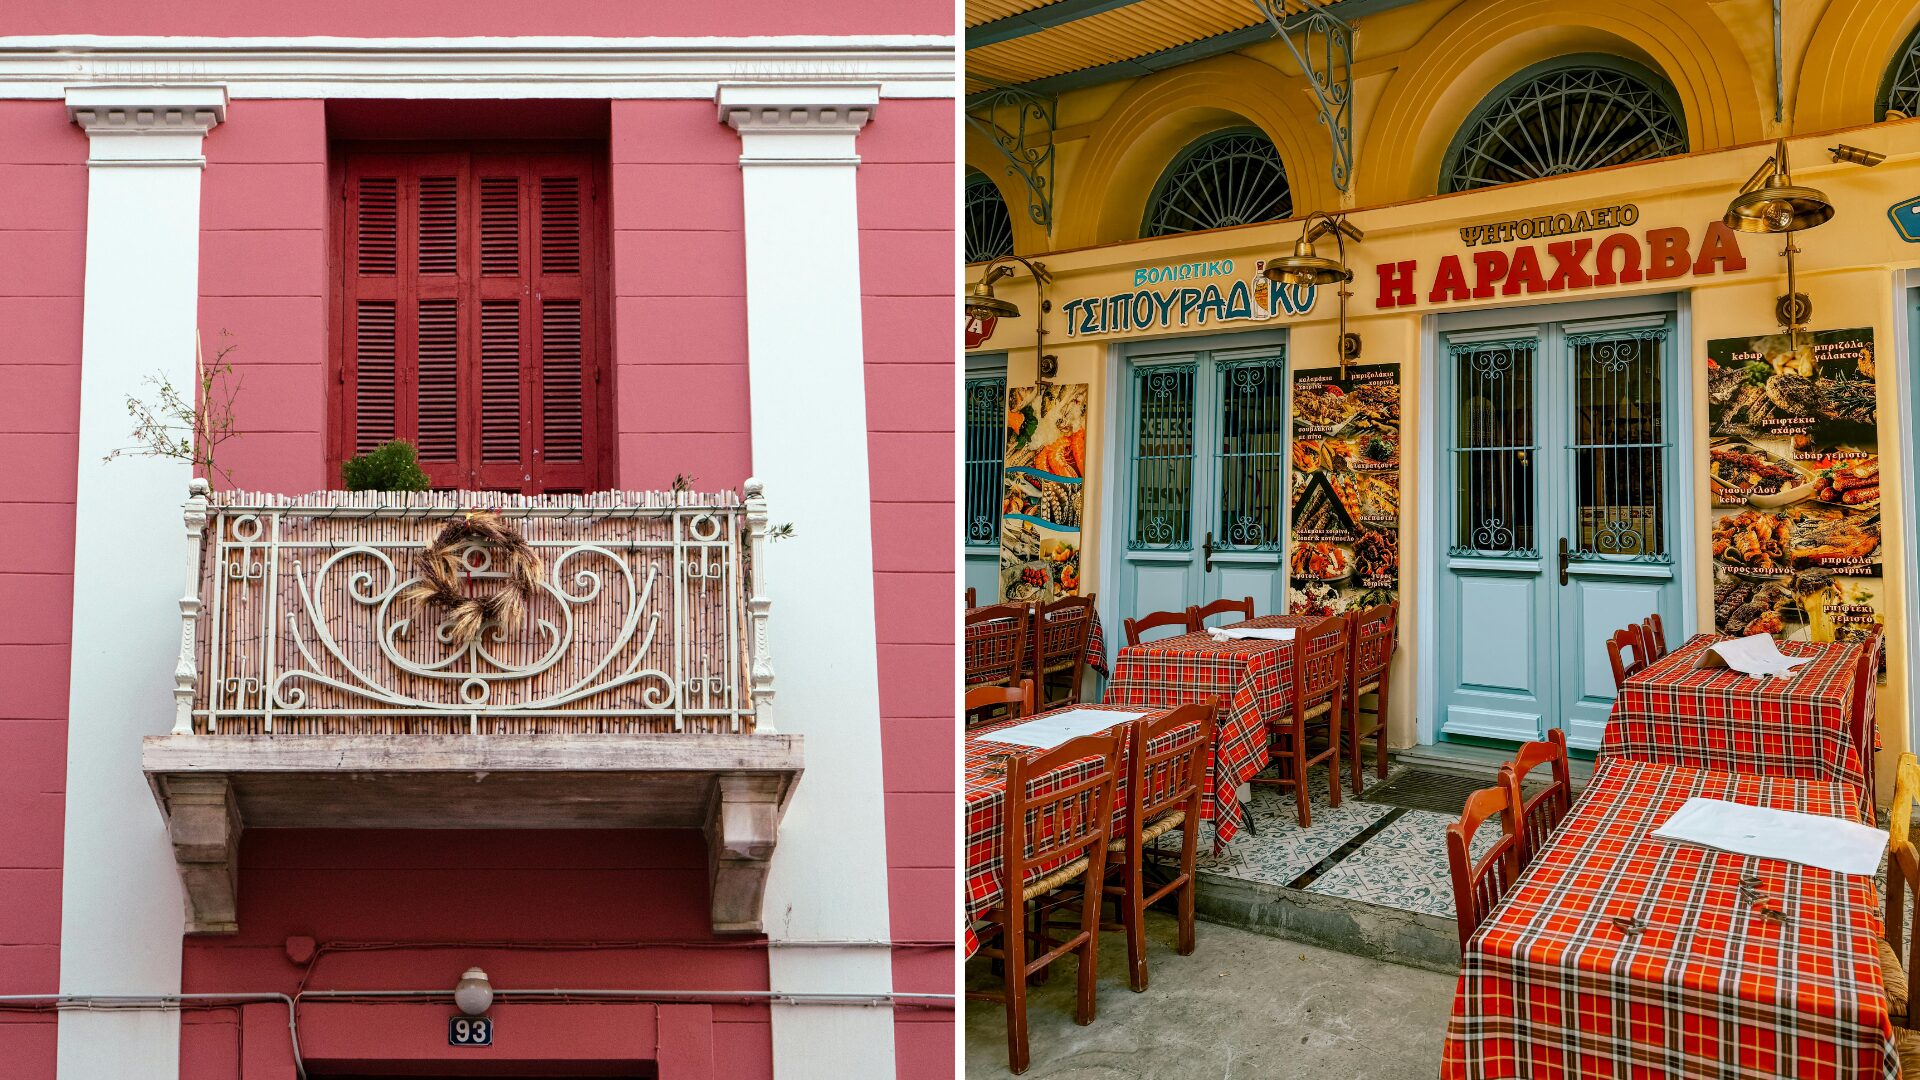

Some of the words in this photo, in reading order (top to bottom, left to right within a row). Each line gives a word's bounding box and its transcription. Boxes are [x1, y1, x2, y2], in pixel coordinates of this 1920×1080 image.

[1460, 204, 1640, 247] ΨΗΤΟΠΩΛΕΙΟ
[1134, 259, 1234, 287] ΒΟΛΙΩΤΙΚΟ
[1376, 259, 1417, 309] Η
[1428, 220, 1747, 303] ΑΡΑΧΩΒΑ
[1732, 352, 1763, 362] kebap
[1793, 451, 1824, 461] kebap
[1719, 496, 1748, 505] kebap
[456, 1019, 486, 1043] 93
